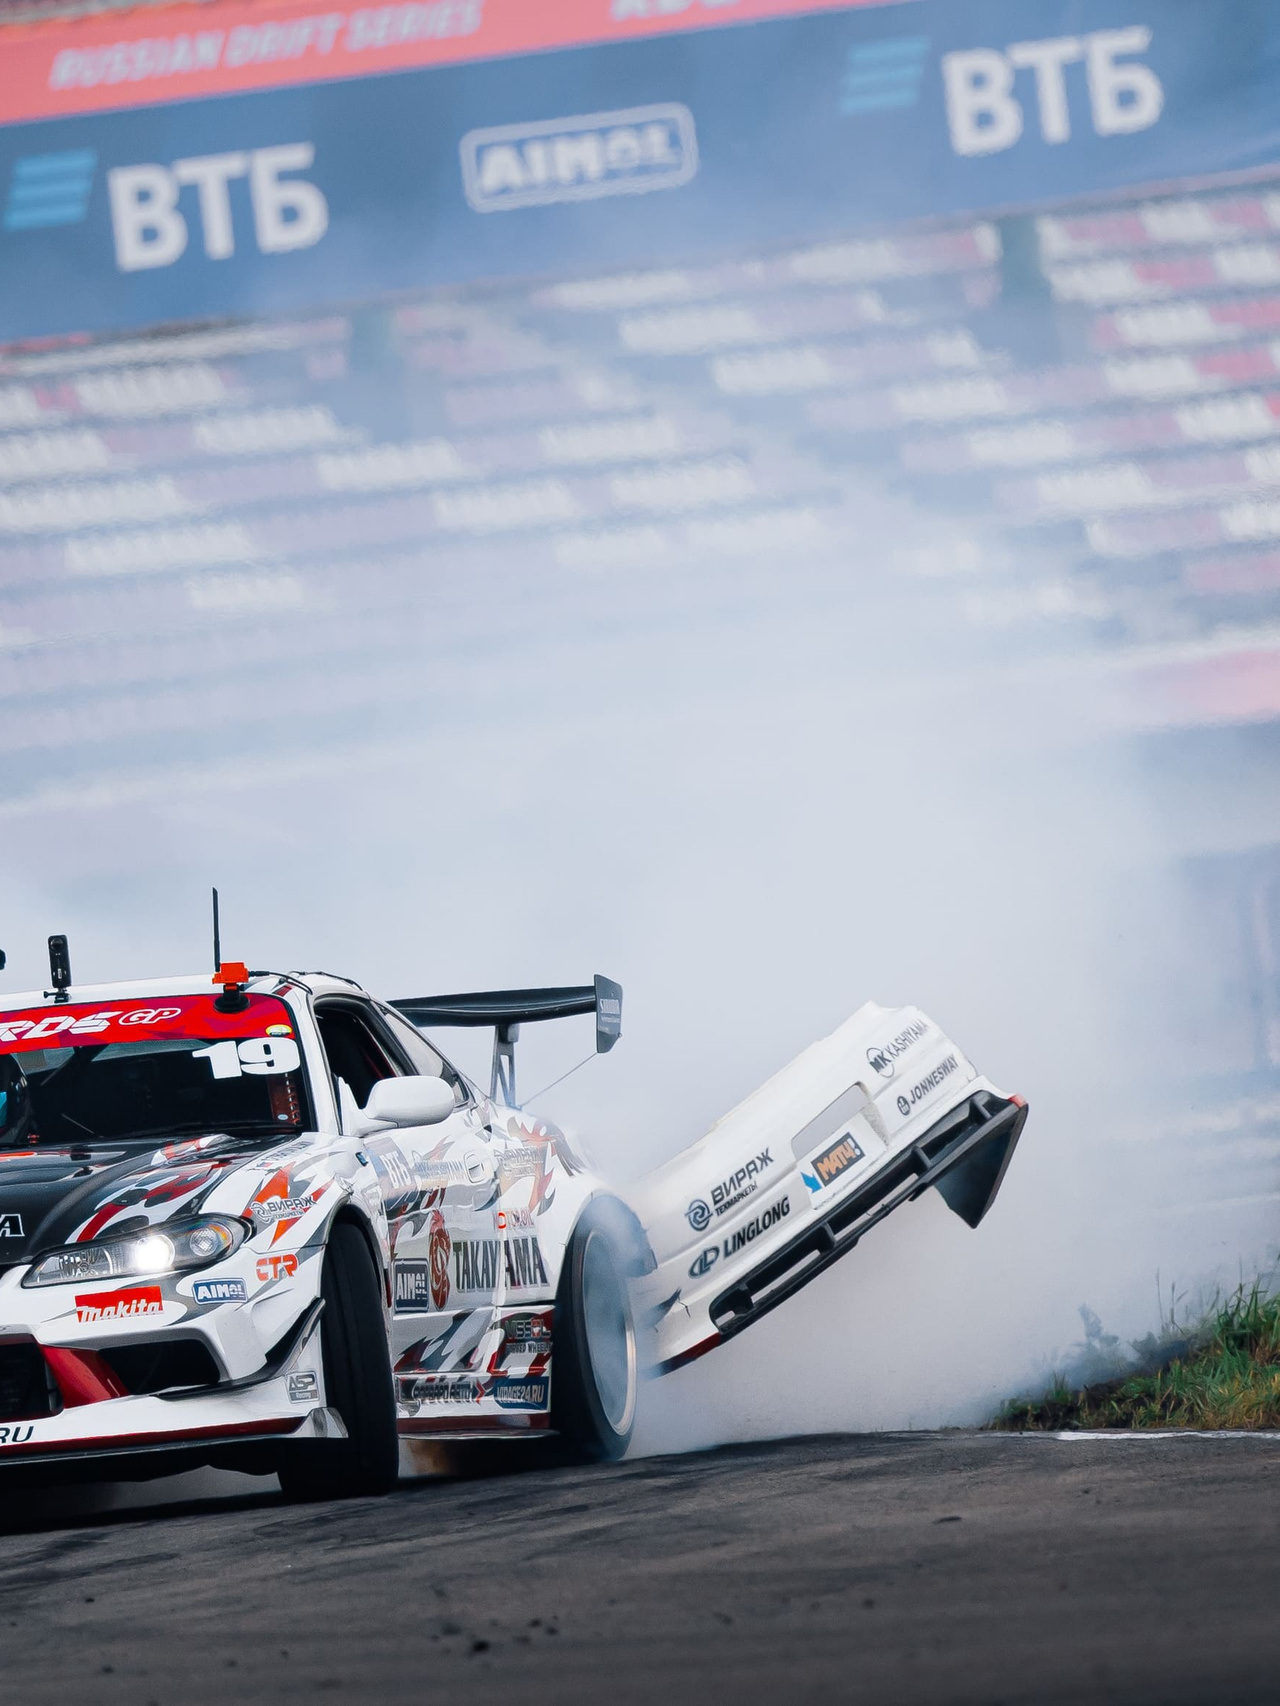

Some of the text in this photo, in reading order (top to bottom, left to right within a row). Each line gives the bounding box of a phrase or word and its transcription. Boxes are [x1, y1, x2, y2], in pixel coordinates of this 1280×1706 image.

[49, 0, 486, 90] RUSSIAN DRIFT SERIES
[942, 25, 1164, 157] ВТБ
[472, 126, 683, 195] AIMOL
[107, 143, 330, 273] ВТБ
[118, 1008, 182, 1026] GP
[192, 1036, 301, 1080] 19
[869, 1018, 930, 1073] MK KASHIYAMA
[909, 1054, 959, 1105] JONNESWAY
[379, 1151, 412, 1189] ВТБ
[711, 1147, 774, 1206] ВИРАЖ
[267, 1195, 317, 1212] ВИРАЖ
[715, 1180, 758, 1217] ТЕХМАРКЕТЫ
[723, 1196, 790, 1259] LINGLONG
[256, 1254, 299, 1281] CTR
[396, 1272, 427, 1301] AIMOL
[452, 1237, 550, 1293] TAKAYAMA
[198, 1282, 245, 1300] AIMOL
[289, 1374, 315, 1391] ASP
